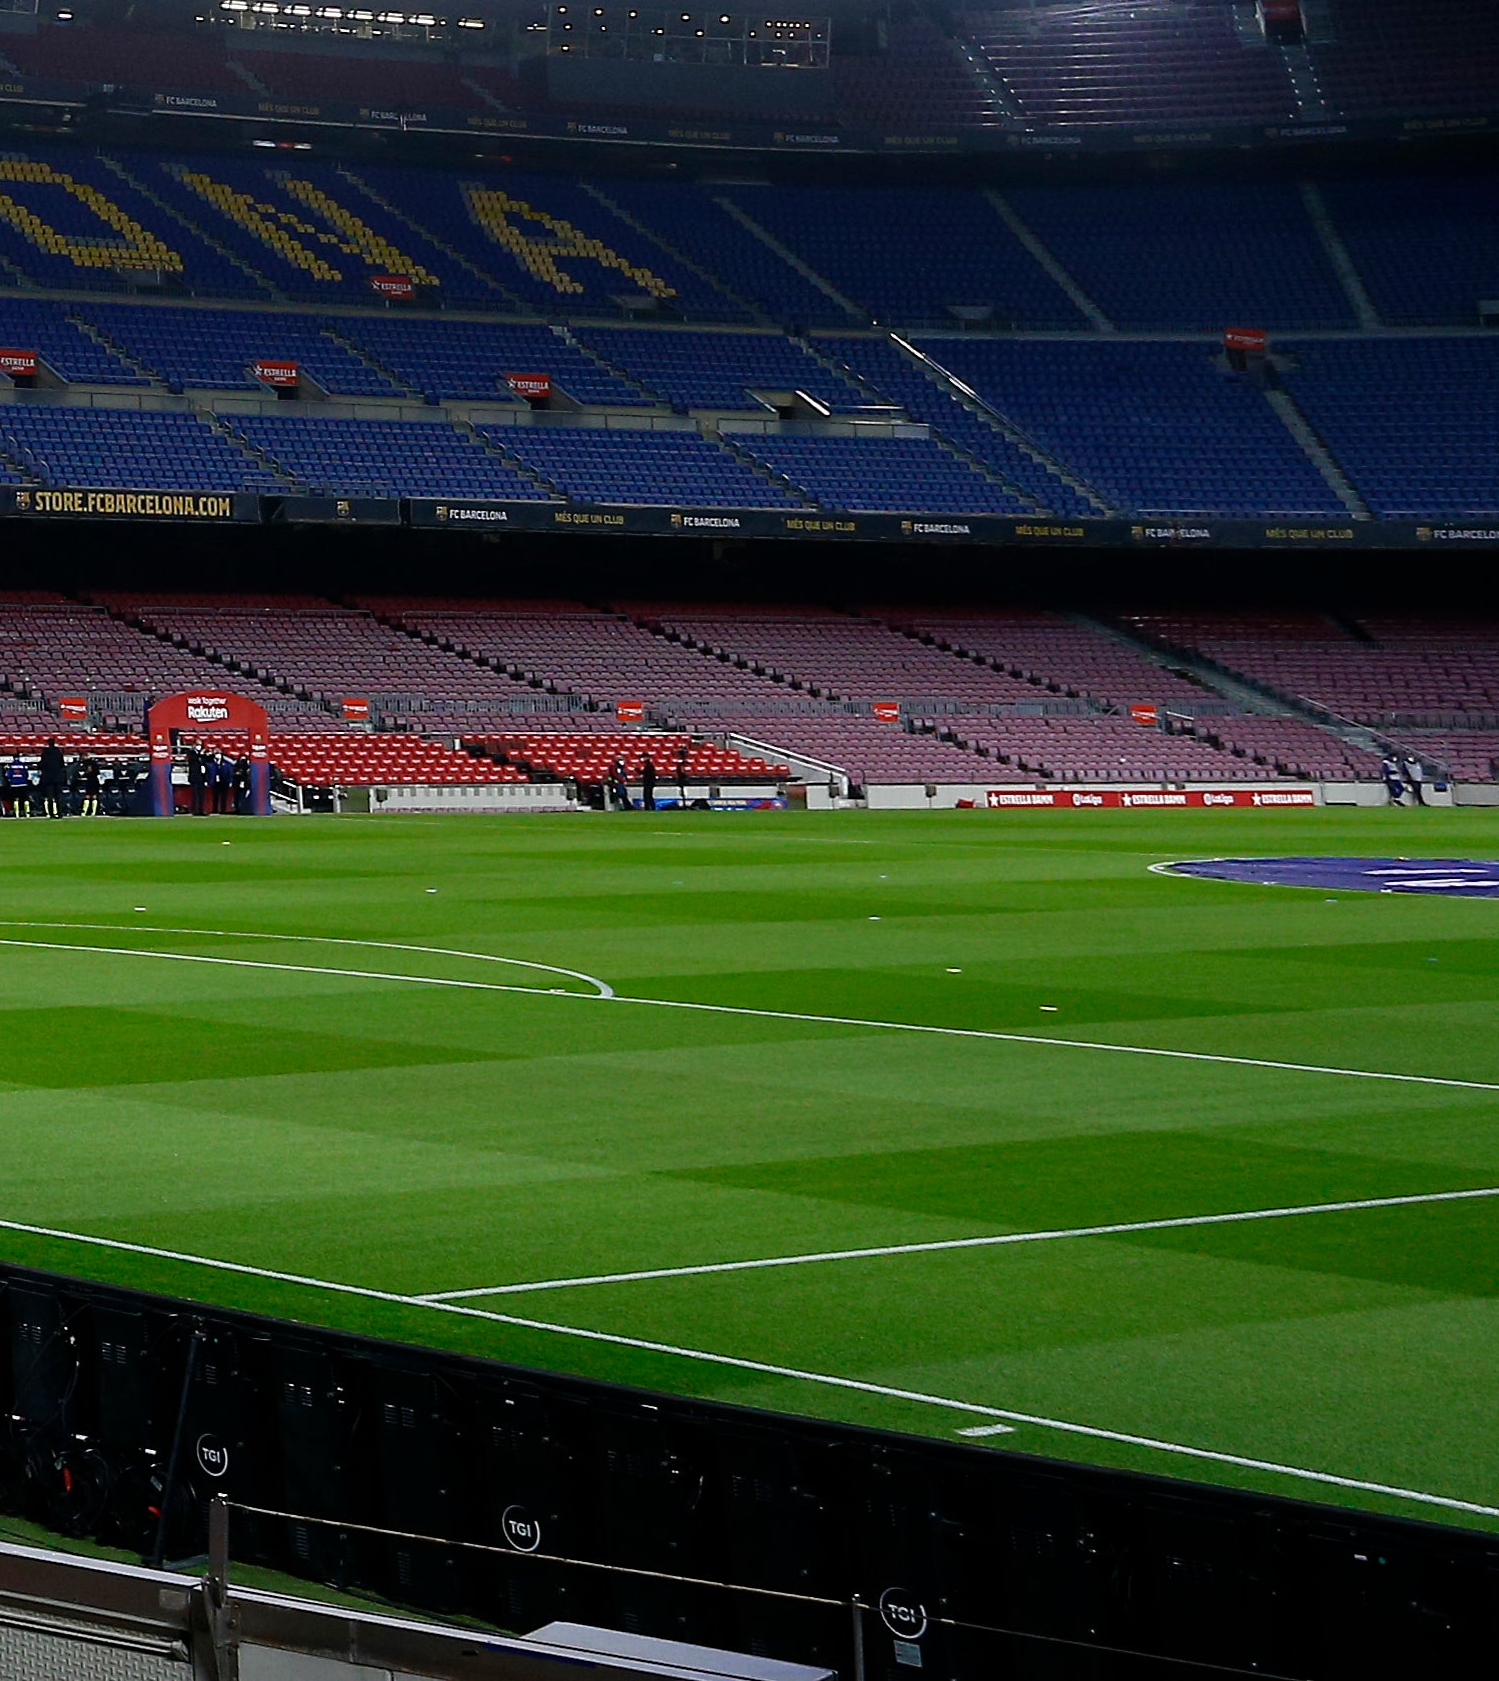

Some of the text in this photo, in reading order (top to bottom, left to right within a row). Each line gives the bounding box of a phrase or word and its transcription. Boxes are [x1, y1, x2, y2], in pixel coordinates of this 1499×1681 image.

[381, 283, 412, 291] ESTRELLA
[1, 357, 34, 367] ESTRELLA
[263, 368, 296, 377] ESTRELLA
[517, 381, 549, 389] ESTRELLA
[35, 493, 230, 517] STORE.FCBARCELONA.COM
[449, 509, 507, 521] FC BARCELONA
[683, 516, 740, 528] FC BARCELONA
[914, 523, 970, 534] FC BARCELONA
[188, 706, 227, 719] Rakuten
[202, 1446, 220, 1464] TGI
[509, 1520, 531, 1537] TGI
[888, 1603, 916, 1623] TGI
